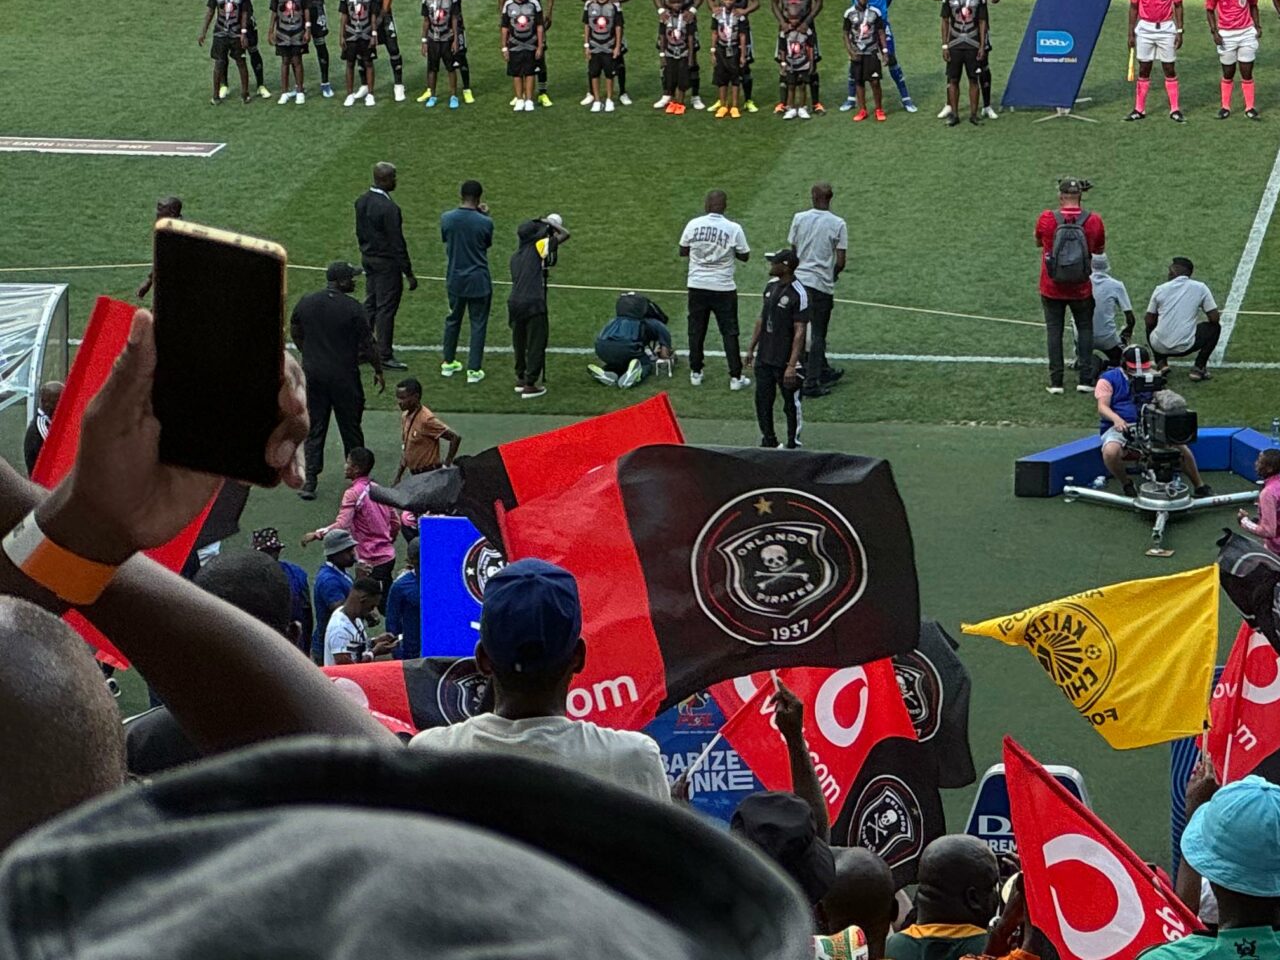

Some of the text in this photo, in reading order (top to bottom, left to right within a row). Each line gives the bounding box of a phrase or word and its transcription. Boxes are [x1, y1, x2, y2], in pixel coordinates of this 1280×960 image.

[692, 226, 730, 249] REDBAT
[737, 533, 808, 556] ORLANDO
[756, 582, 815, 603] PIRATES
[771, 618, 809, 640] 1937
